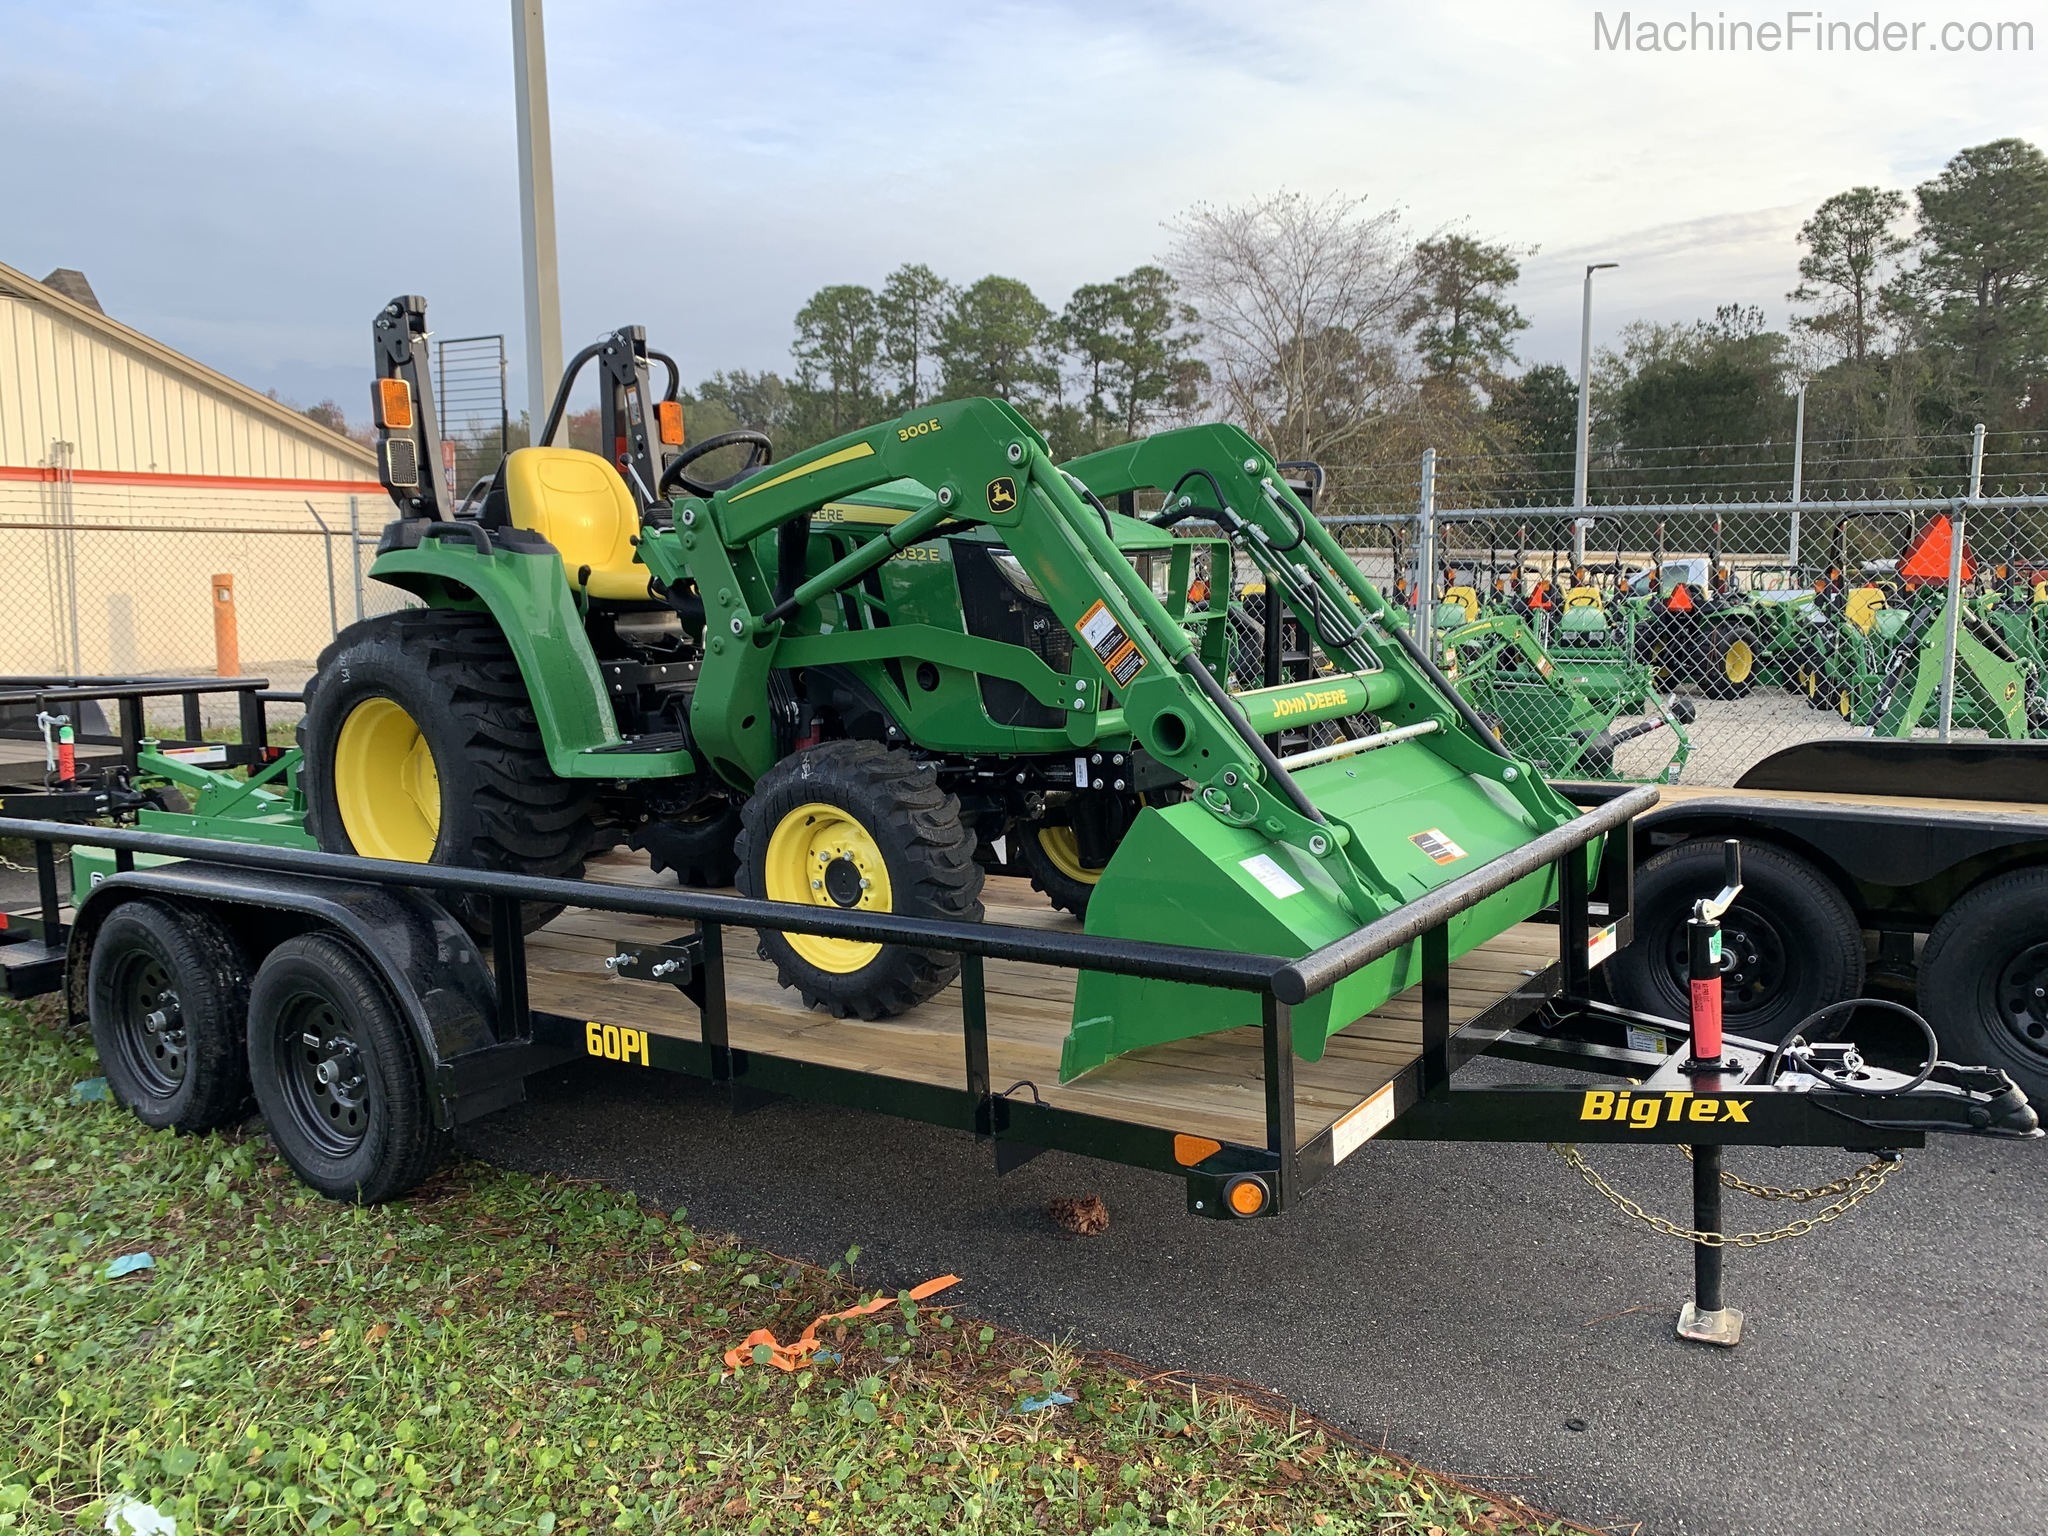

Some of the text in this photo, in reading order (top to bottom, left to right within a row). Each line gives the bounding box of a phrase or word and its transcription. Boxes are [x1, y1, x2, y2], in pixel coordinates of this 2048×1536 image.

[897, 418, 943, 442] 300E
[1271, 688, 1348, 718] JOHN DEERE
[586, 1021, 650, 1067] 60PI
[1579, 1090, 1754, 1129] BigTex
